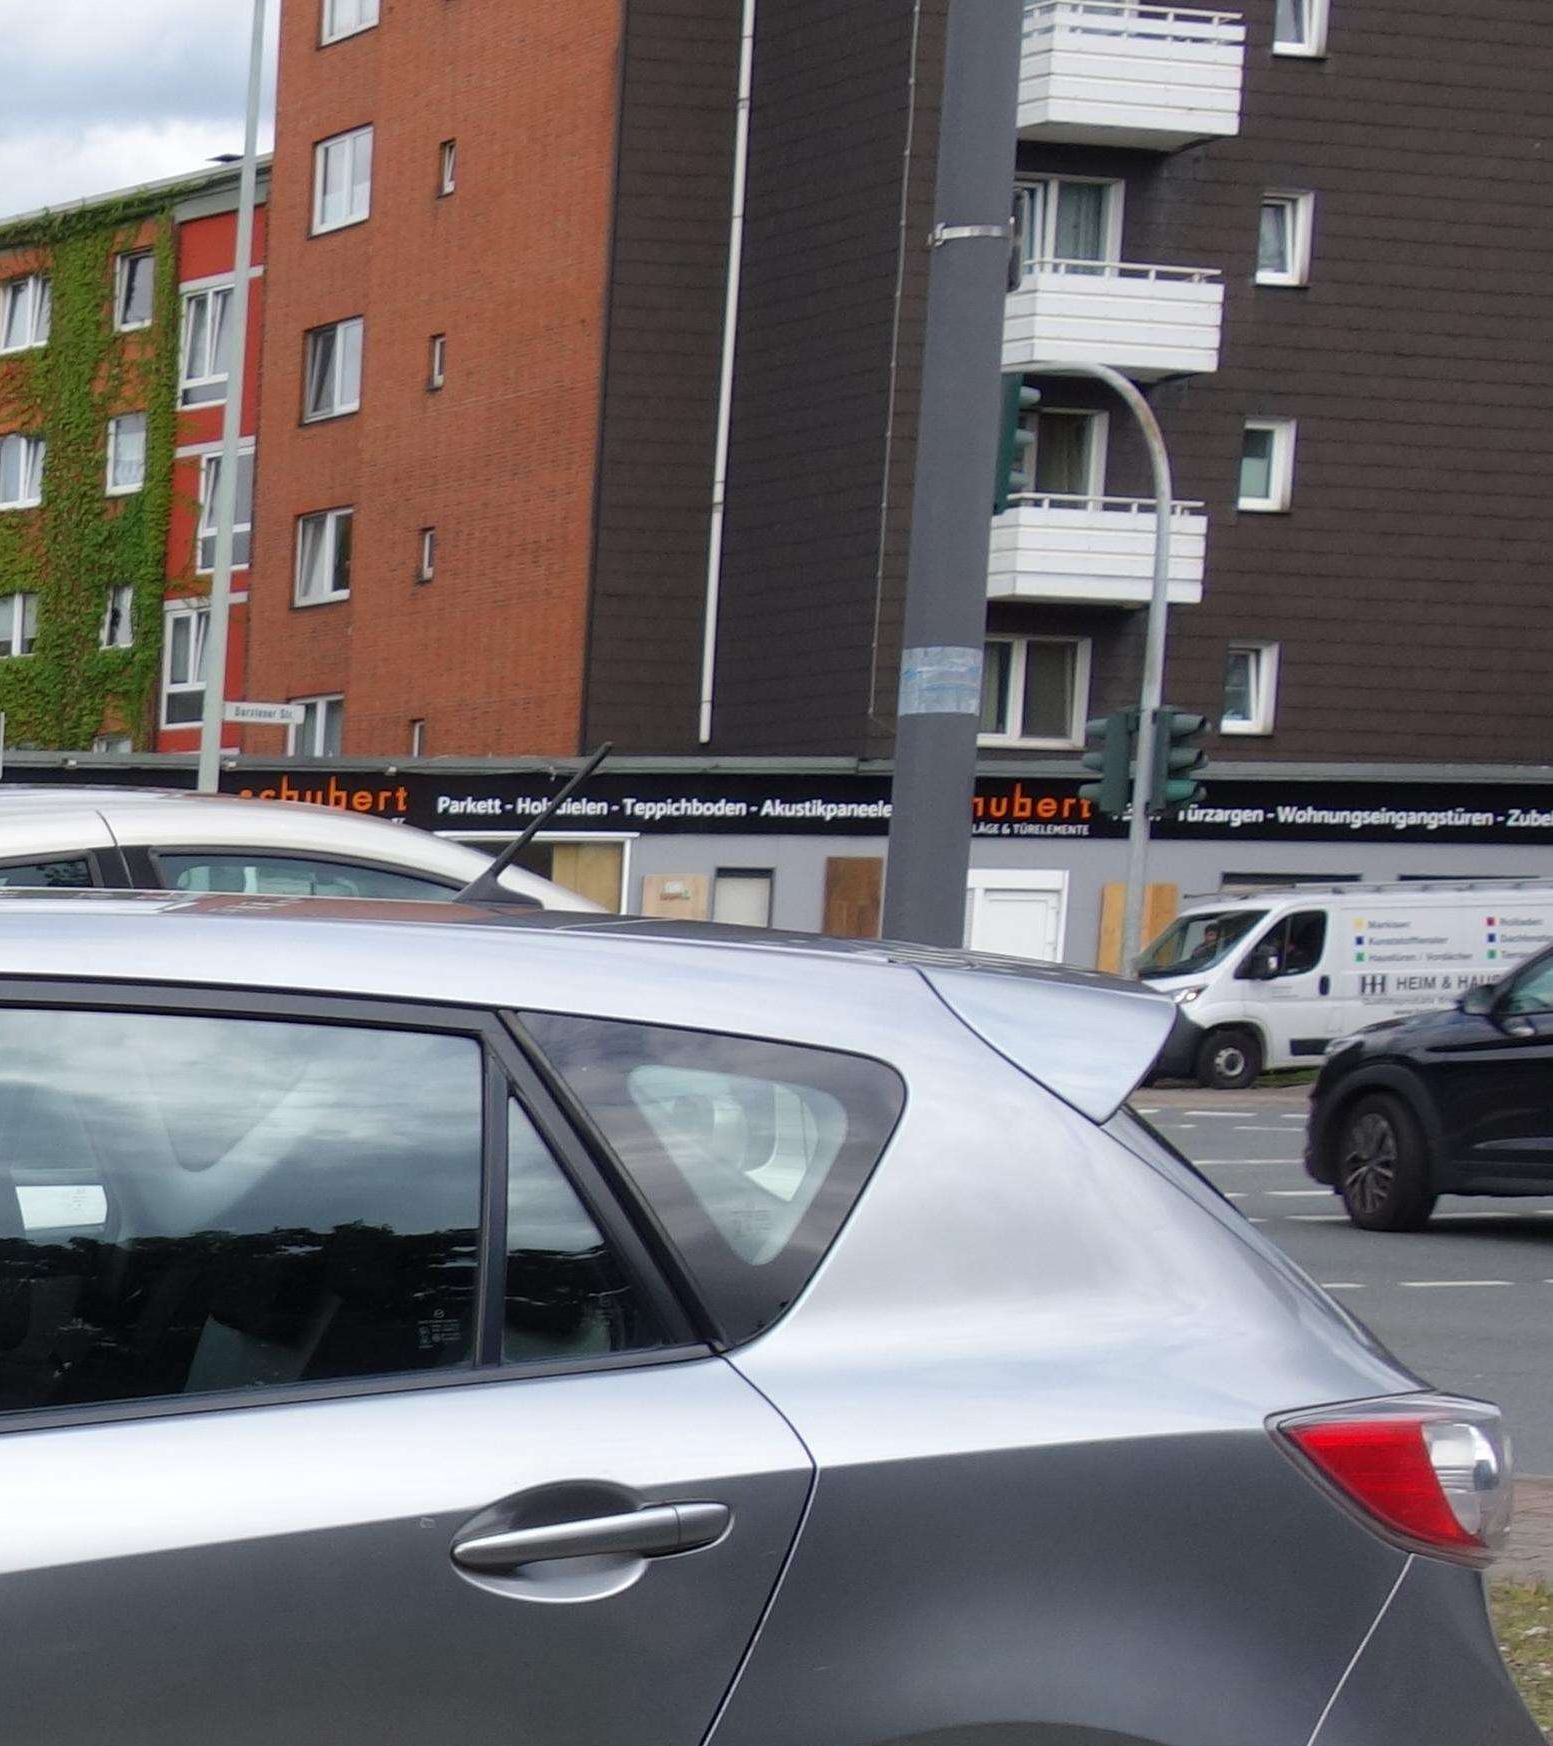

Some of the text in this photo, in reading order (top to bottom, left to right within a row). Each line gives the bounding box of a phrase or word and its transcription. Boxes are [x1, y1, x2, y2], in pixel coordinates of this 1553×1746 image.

[437, 796, 502, 815] Parkett
[516, 797, 608, 816] Holielen
[623, 798, 747, 821] Teppichboden
[760, 799, 893, 822] Akustikpaneele
[972, 782, 1093, 819] ubert
[1012, 822, 1090, 837] TÜRELEMENTE
[1276, 806, 1493, 833] Wohnungseingangstüren
[1396, 974, 1436, 992] HEIM
[1441, 974, 1452, 990] &
